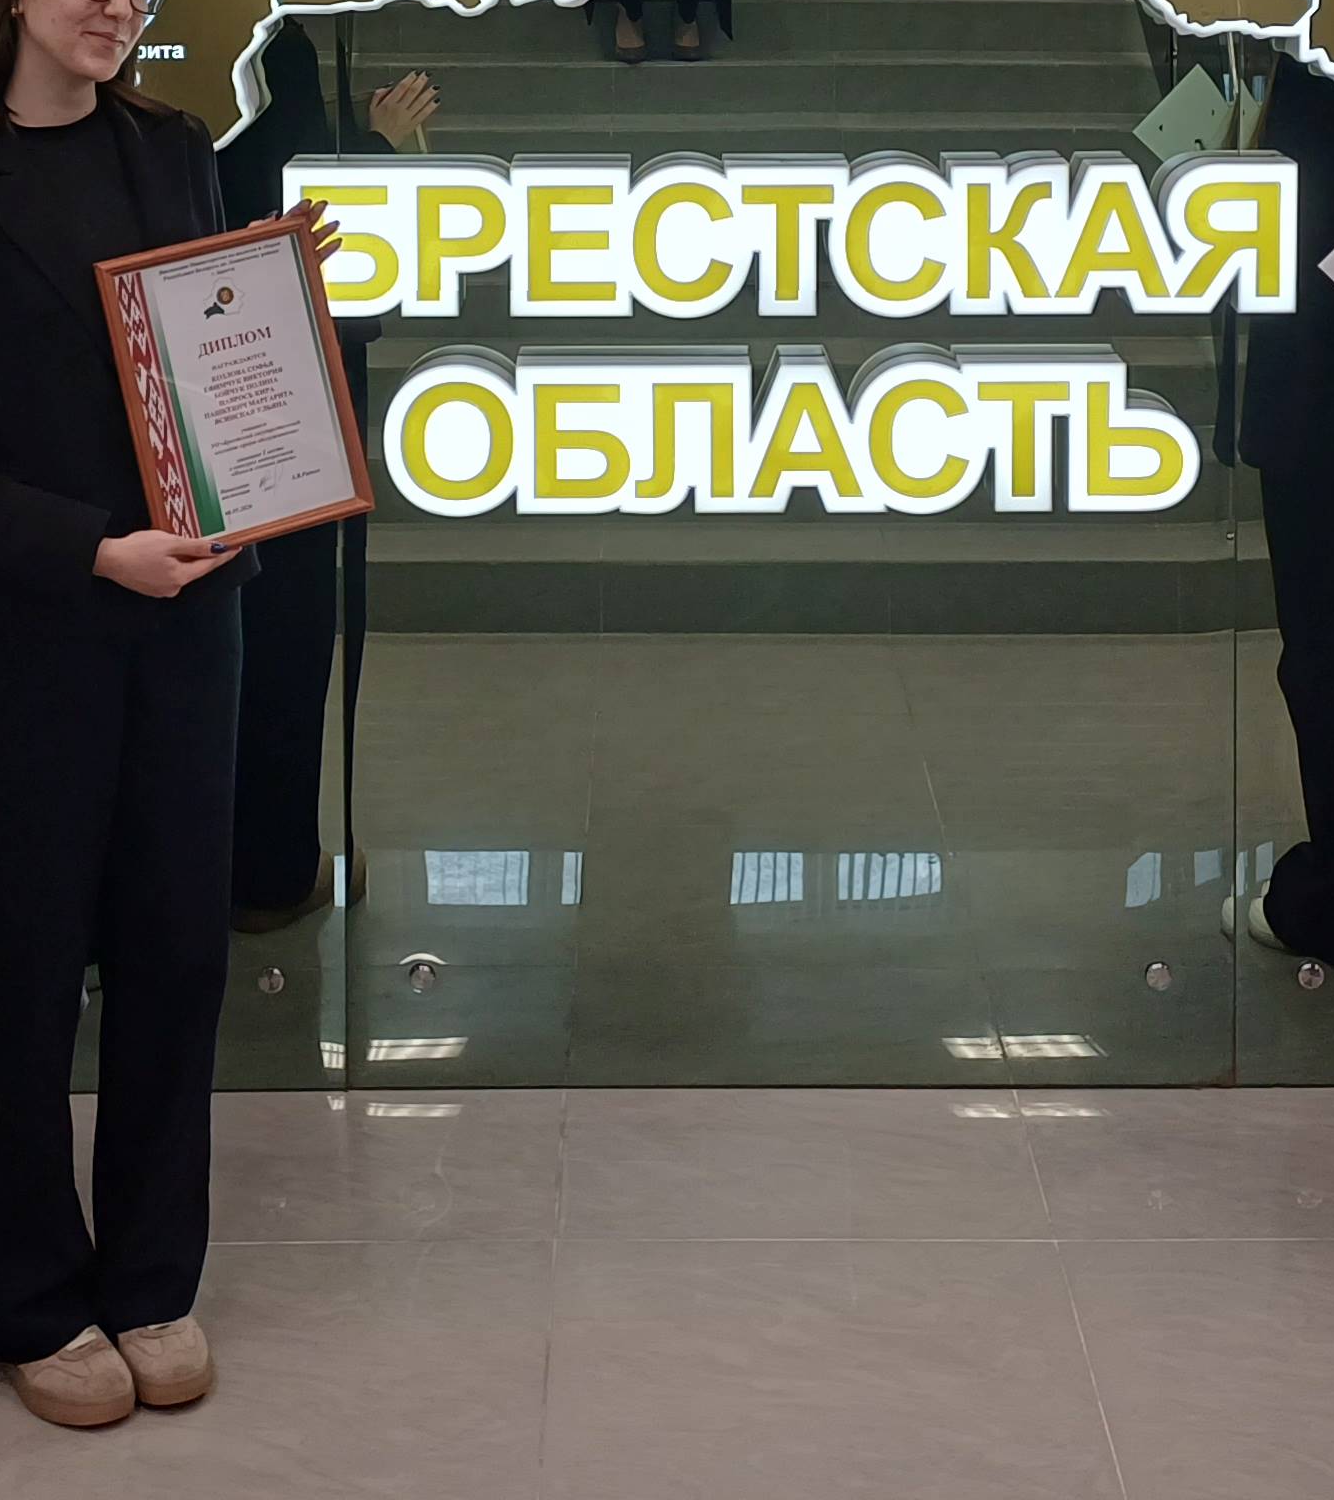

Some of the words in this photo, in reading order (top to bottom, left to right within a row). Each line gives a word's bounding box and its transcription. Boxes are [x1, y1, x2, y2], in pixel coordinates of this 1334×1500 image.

[137, 44, 185, 60] рита
[299, 180, 1281, 303] БРЕСТСКАЯ
[198, 326, 271, 359] ДИПЛОМ
[399, 377, 1185, 501] ОБЛАСТЬ
